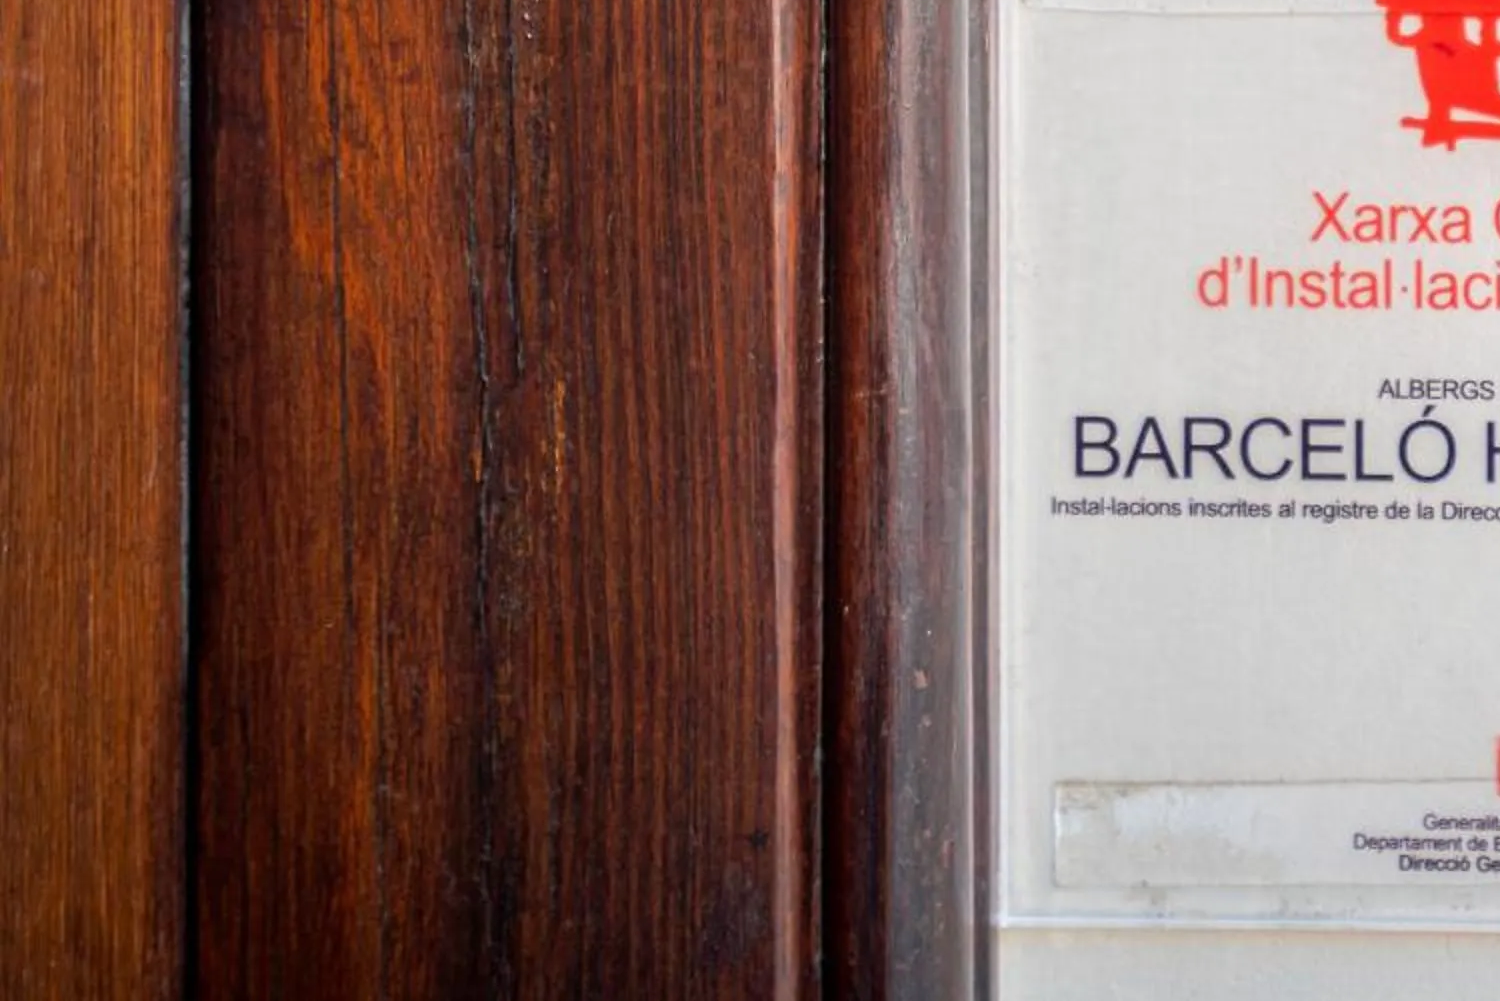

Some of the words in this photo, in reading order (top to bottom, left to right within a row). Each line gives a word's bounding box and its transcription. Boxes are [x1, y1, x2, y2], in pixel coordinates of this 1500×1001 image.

[1311, 191, 1474, 245] Xarxa
[1378, 378, 1495, 401] ALBERGS
[1074, 405, 1457, 484] BARCELÓ
[1188, 497, 1272, 519] inscrites
[1278, 499, 1296, 519] al
[1302, 500, 1378, 525] registre
[1383, 501, 1410, 521] de
[1416, 501, 1435, 521] la
[1353, 833, 1462, 854] Departament
[1467, 836, 1489, 852] de
[1399, 855, 1471, 872] Direcció
